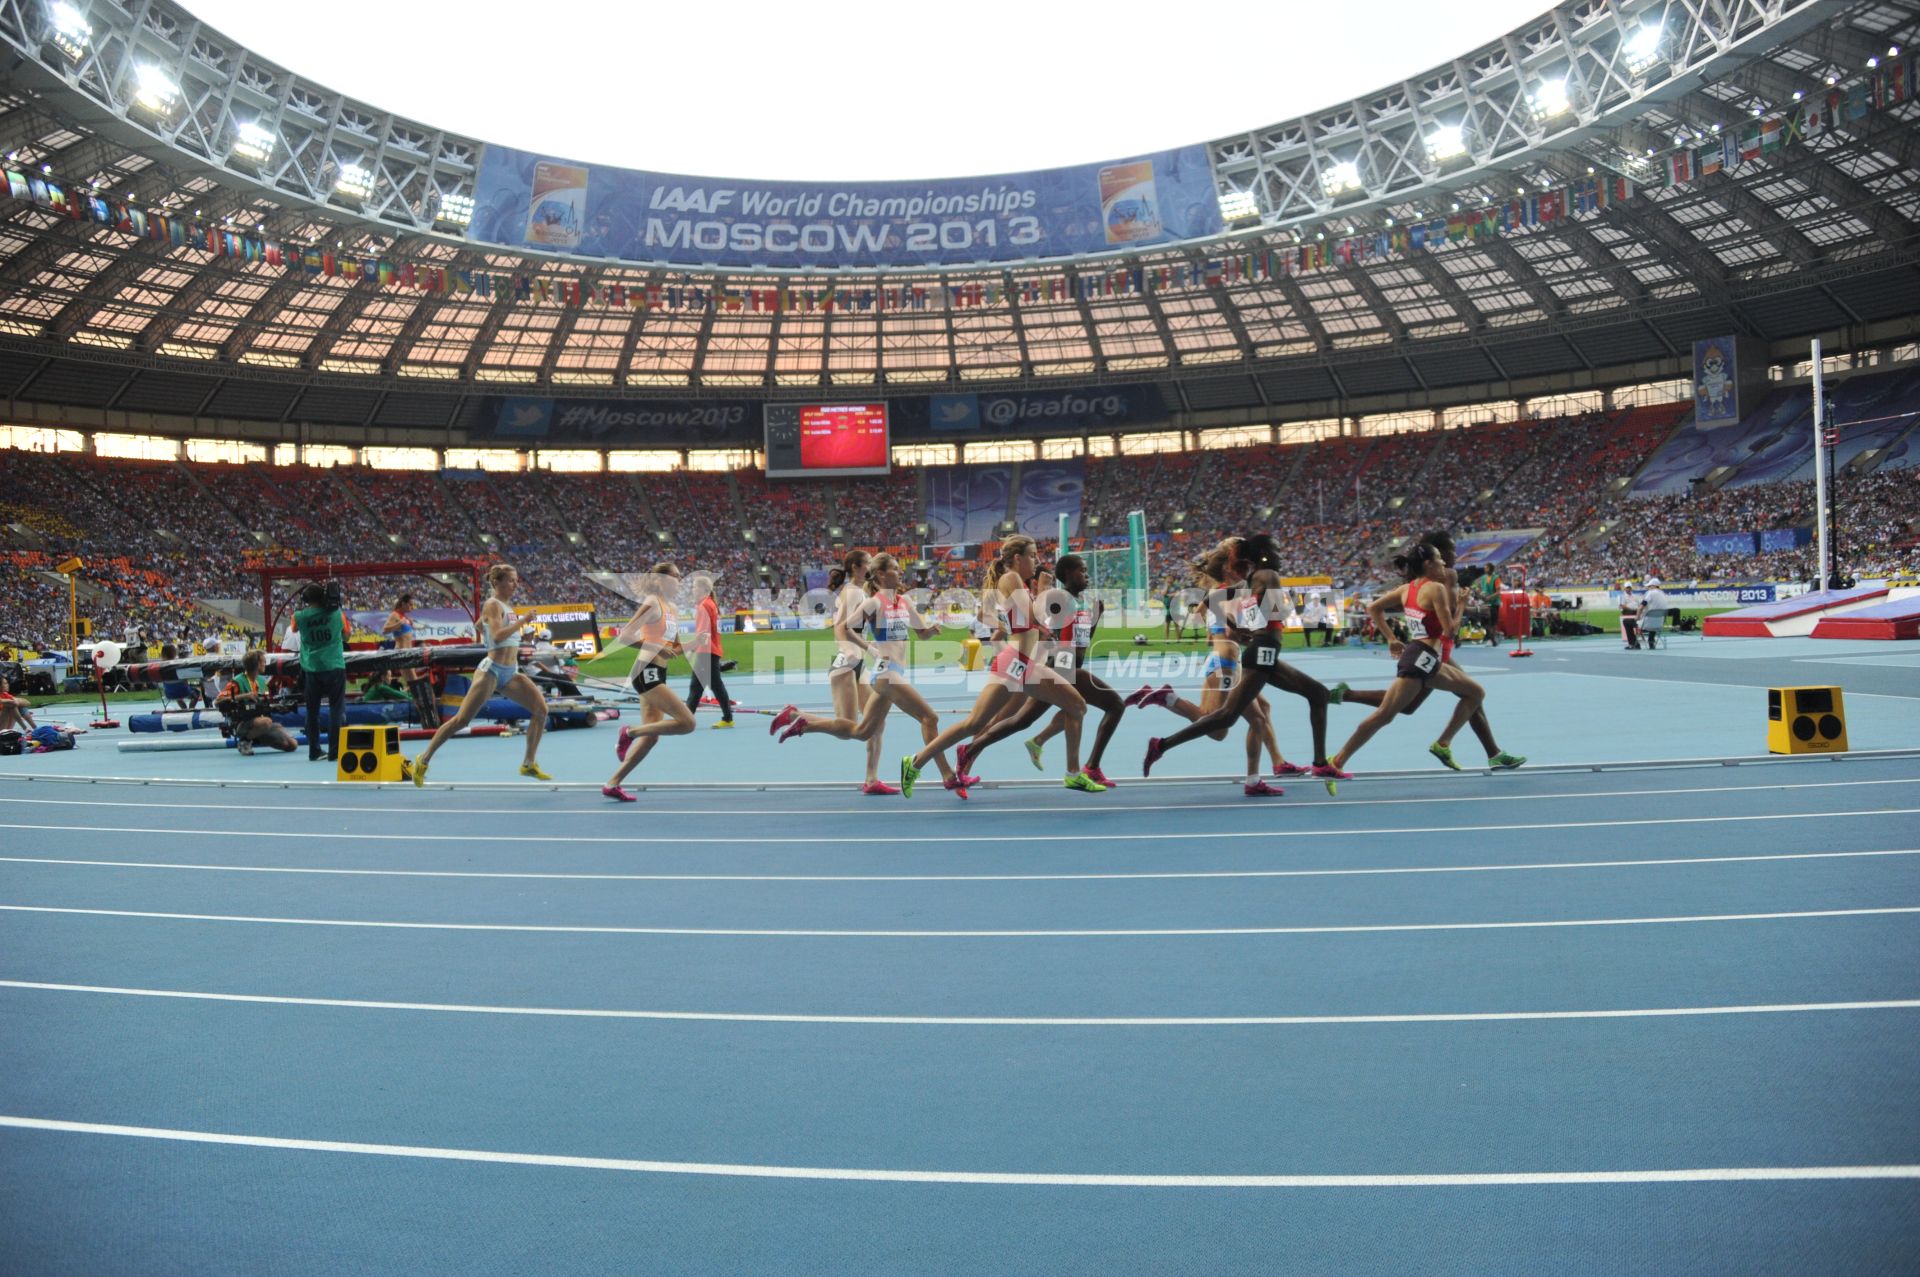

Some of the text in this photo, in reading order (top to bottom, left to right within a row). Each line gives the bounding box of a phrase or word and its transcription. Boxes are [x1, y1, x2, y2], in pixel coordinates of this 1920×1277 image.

[648, 186, 1036, 221] IAAF World Championships
[645, 216, 1040, 252] MOSCOW 2013
[986, 394, 1120, 424] @iaaforg
[559, 406, 744, 428] #Moscow2013
[1741, 589, 1767, 601] 2013
[311, 629, 332, 642] 106
[429, 626, 456, 636] TDK
[1261, 650, 1273, 663] 11
[1421, 656, 1431, 669] 2
[648, 670, 655, 681] 5
[1010, 661, 1025, 678] 10
[1223, 676, 1231, 689] 9
